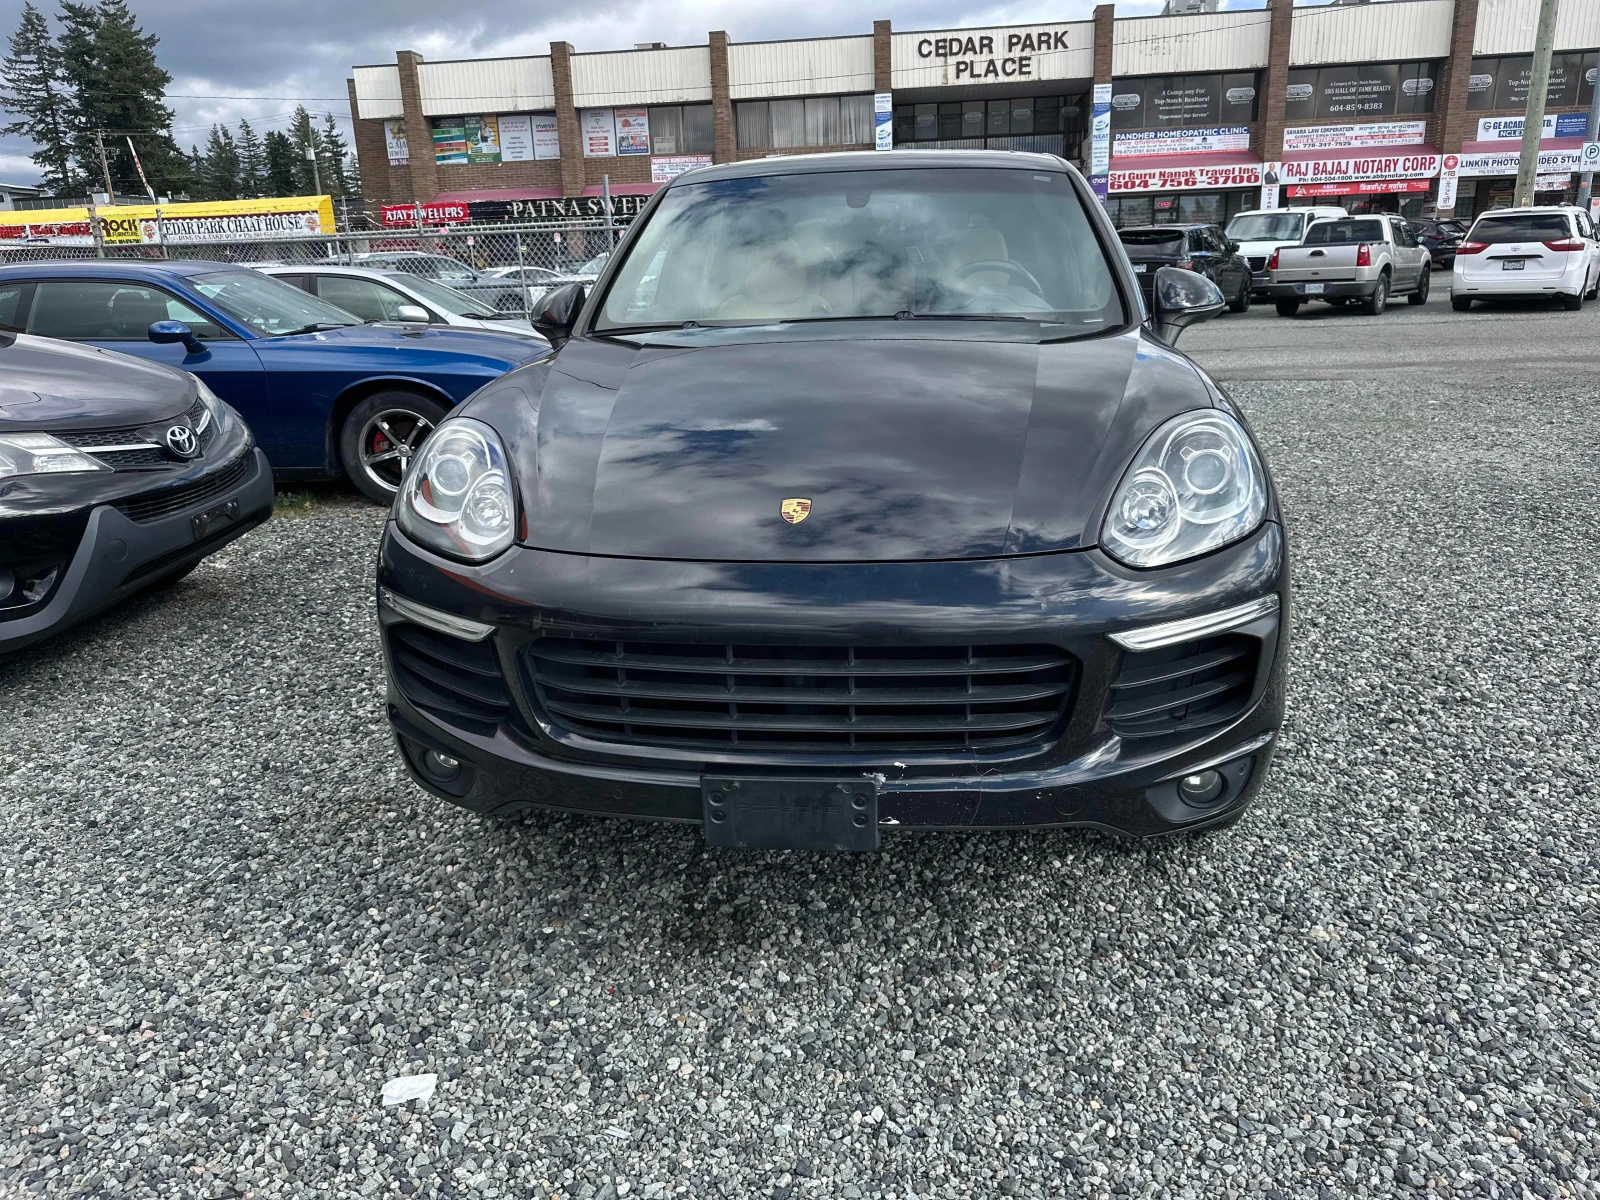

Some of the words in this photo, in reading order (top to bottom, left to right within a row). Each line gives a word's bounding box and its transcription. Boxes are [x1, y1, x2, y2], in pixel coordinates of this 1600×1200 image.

[918, 36, 993, 58] CEDAR
[1008, 30, 1069, 52] PARK
[956, 56, 1032, 79] PLACE
[1335, 86, 1349, 94] HALL
[1358, 85, 1373, 93] FAME
[1372, 84, 1392, 92] REALTY
[1502, 120, 1524, 129] ACAD
[1115, 131, 1156, 141] PANDHER
[1156, 127, 1219, 139] HOMEOPATHIC
[1219, 126, 1248, 135] CLINIC
[1589, 147, 1597, 157] P
[1286, 162, 1309, 177] RAJ
[1312, 160, 1350, 176] BAJAJ
[1353, 158, 1400, 174] NOTARY
[1402, 156, 1437, 172] CORP.
[1460, 159, 1490, 168] LINKIN
[1491, 158, 1520, 167] PHOTO
[1538, 156, 1558, 165] IDEO
[1560, 155, 1581, 164] STU
[1109, 172, 1126, 181] Sri
[1127, 172, 1156, 180] Guru
[1158, 170, 1196, 179] Nanak
[1199, 167, 1236, 177] Travel
[1236, 166, 1260, 175] Inc.
[1354, 172, 1424, 180] www.abbynotary.com
[1109, 174, 1260, 190] 604-756-3700
[511, 199, 582, 218] PATNA
[587, 196, 646, 215] SWEE
[385, 209, 407, 221] AJAY
[98, 217, 138, 238] ROCK
[164, 221, 195, 235] EDAR
[196, 220, 226, 234] PARK
[227, 218, 262, 233] CHAAT
[264, 215, 303, 231] HOUSE
